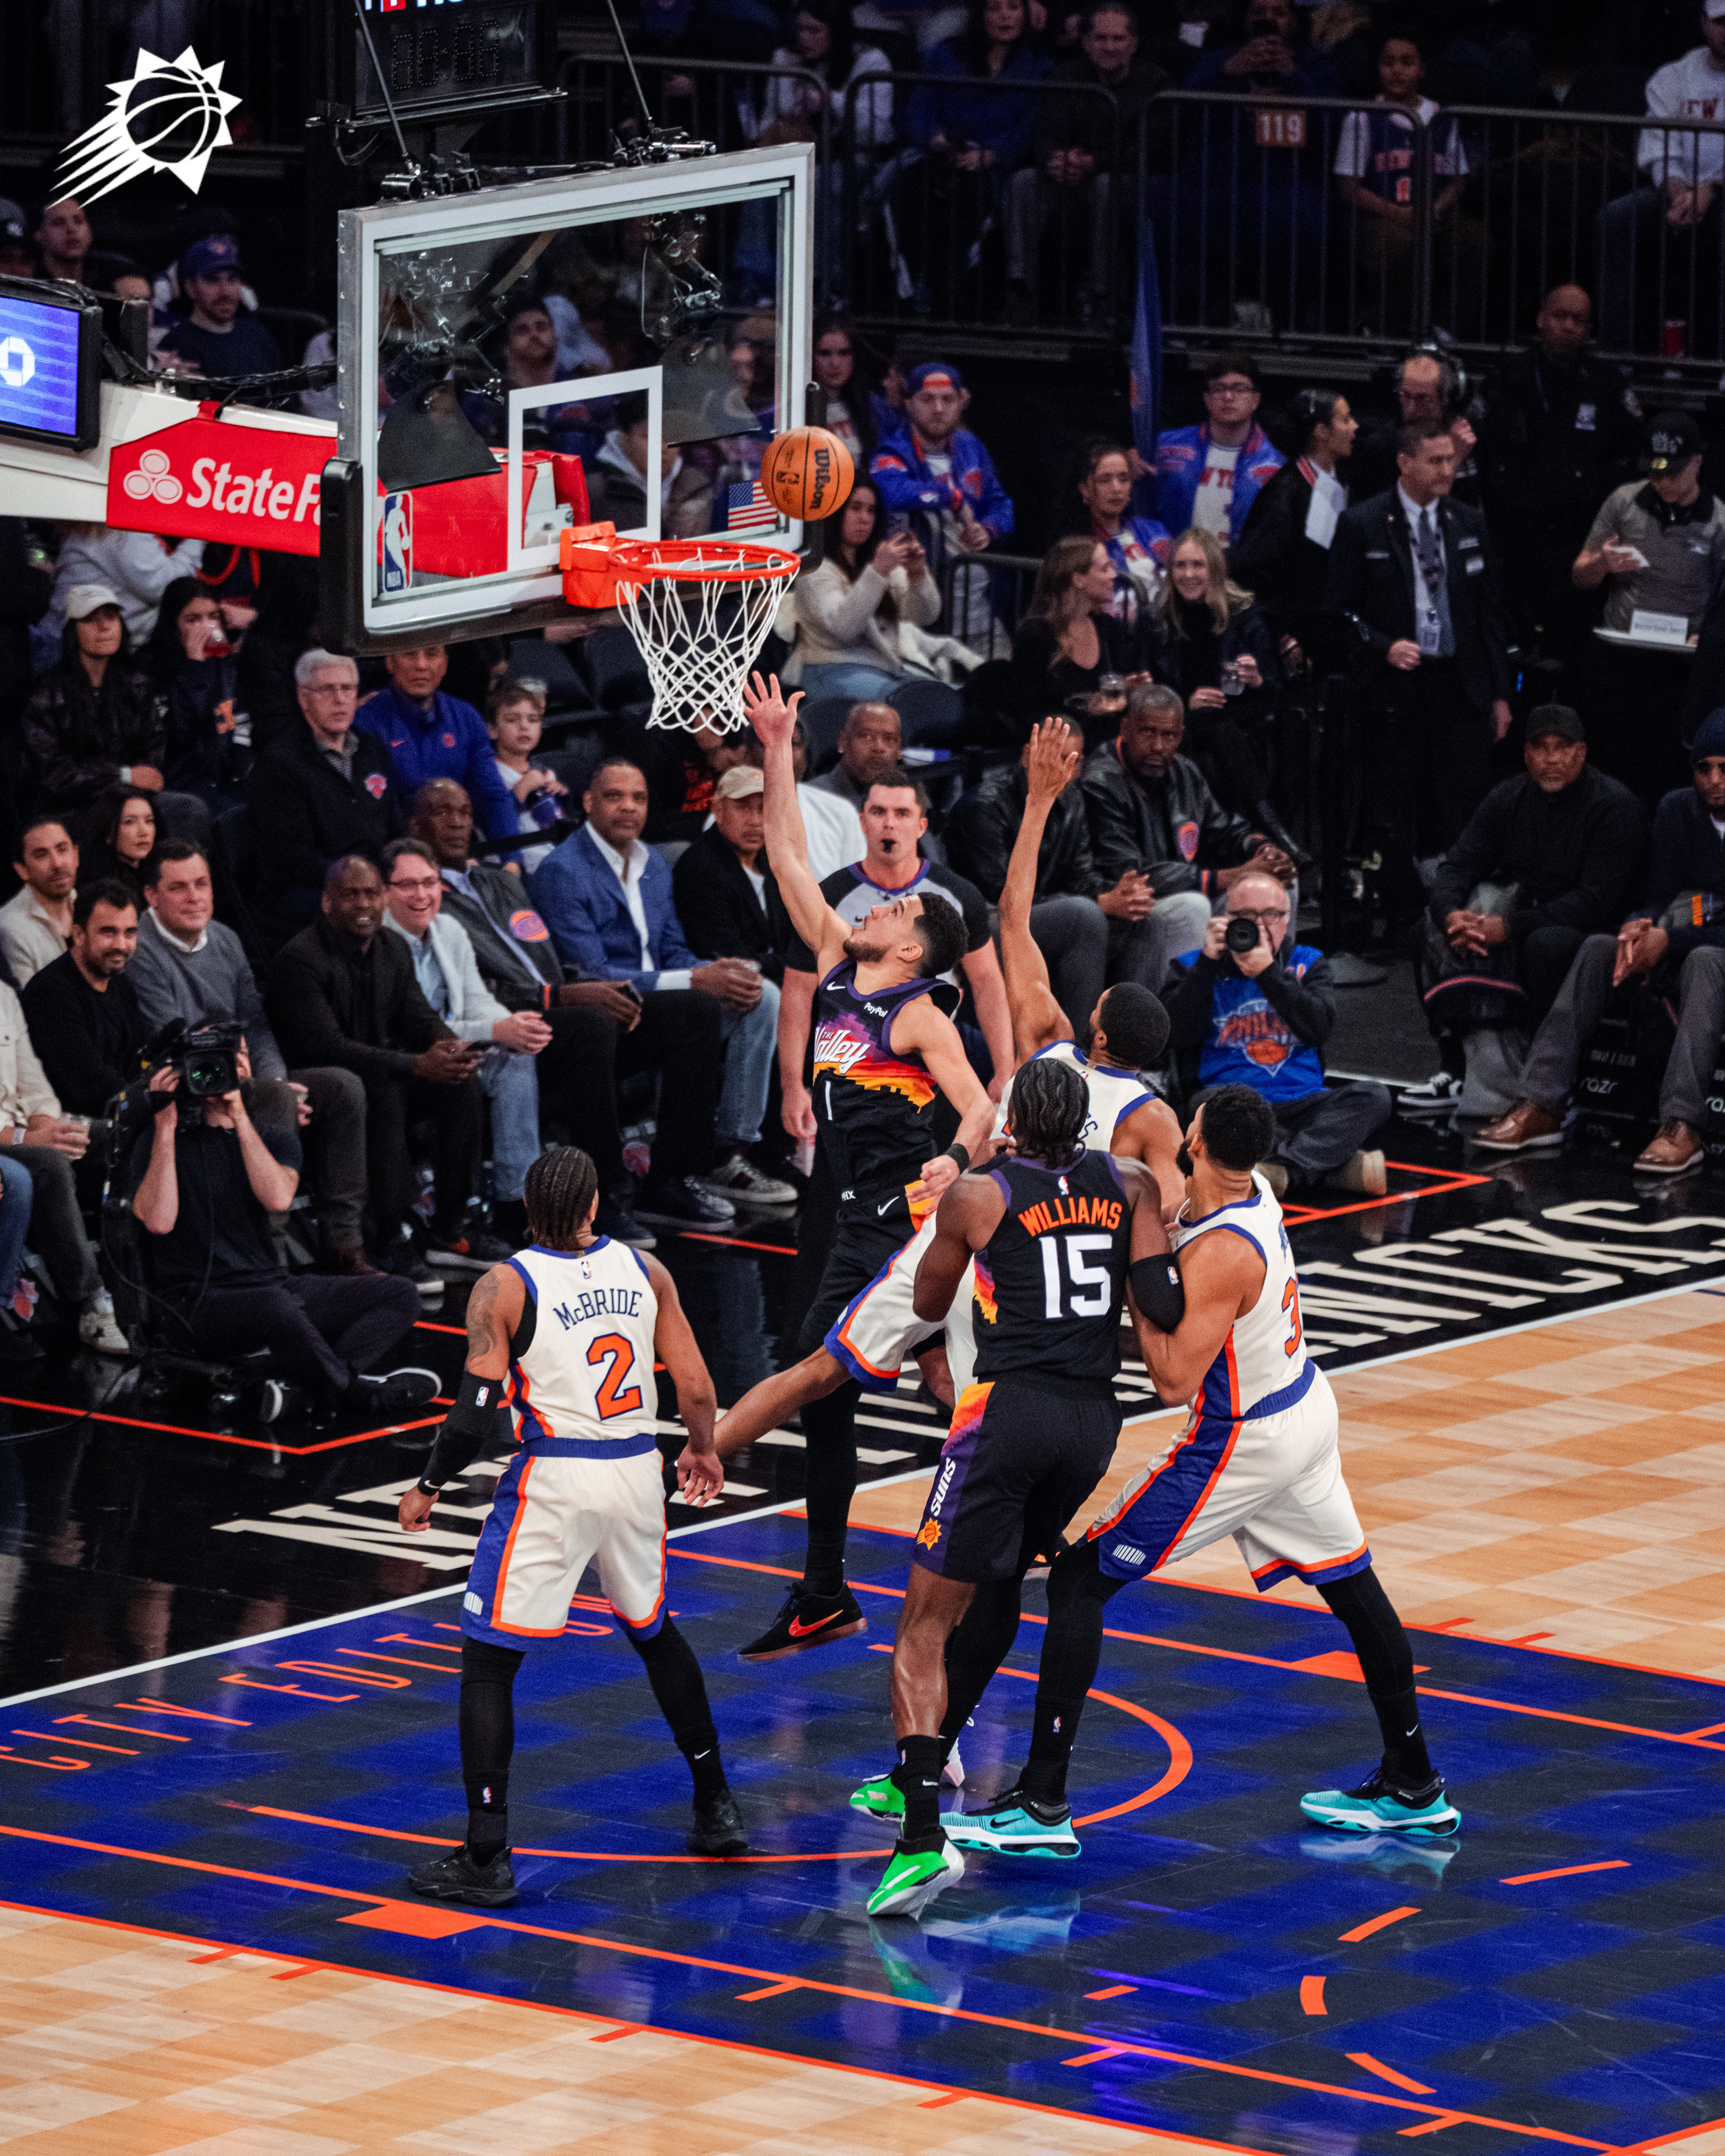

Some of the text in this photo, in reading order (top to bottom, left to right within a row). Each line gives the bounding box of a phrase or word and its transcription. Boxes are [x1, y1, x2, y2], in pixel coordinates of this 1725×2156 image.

[1262, 115, 1302, 142] 119
[864, 1002, 888, 1018] PayPal
[1705, 1096, 1725, 1114] ra
[1018, 1197, 1123, 1237] WILLIAMS
[1039, 1234, 1113, 1319] 15
[553, 1288, 643, 1331] McBRIDE
[586, 1332, 643, 1421] 2
